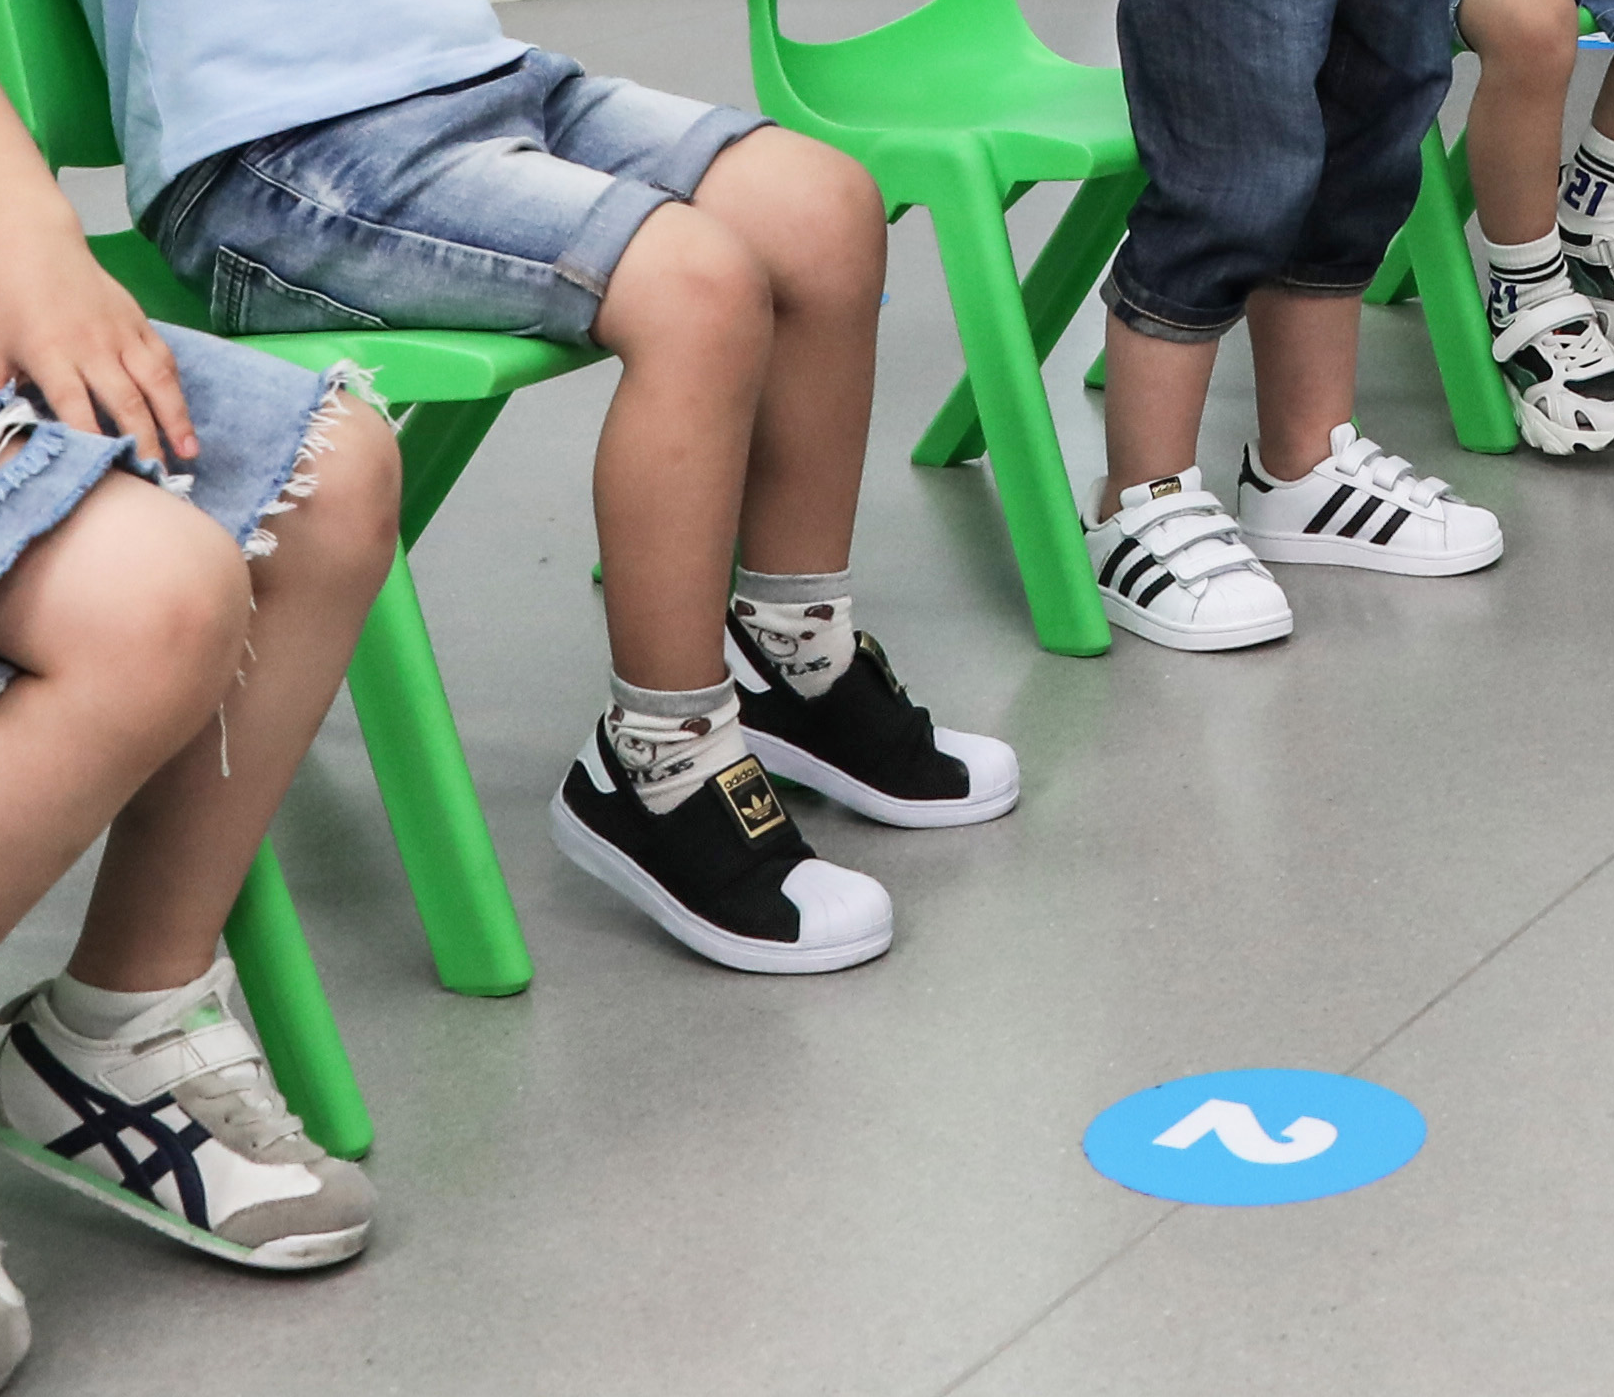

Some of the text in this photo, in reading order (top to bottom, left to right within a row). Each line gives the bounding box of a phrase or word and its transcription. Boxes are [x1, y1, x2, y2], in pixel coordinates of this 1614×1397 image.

[1564, 167, 1608, 217] 21
[724, 767, 760, 790] adidas
[1152, 1097, 1338, 1165] 2
